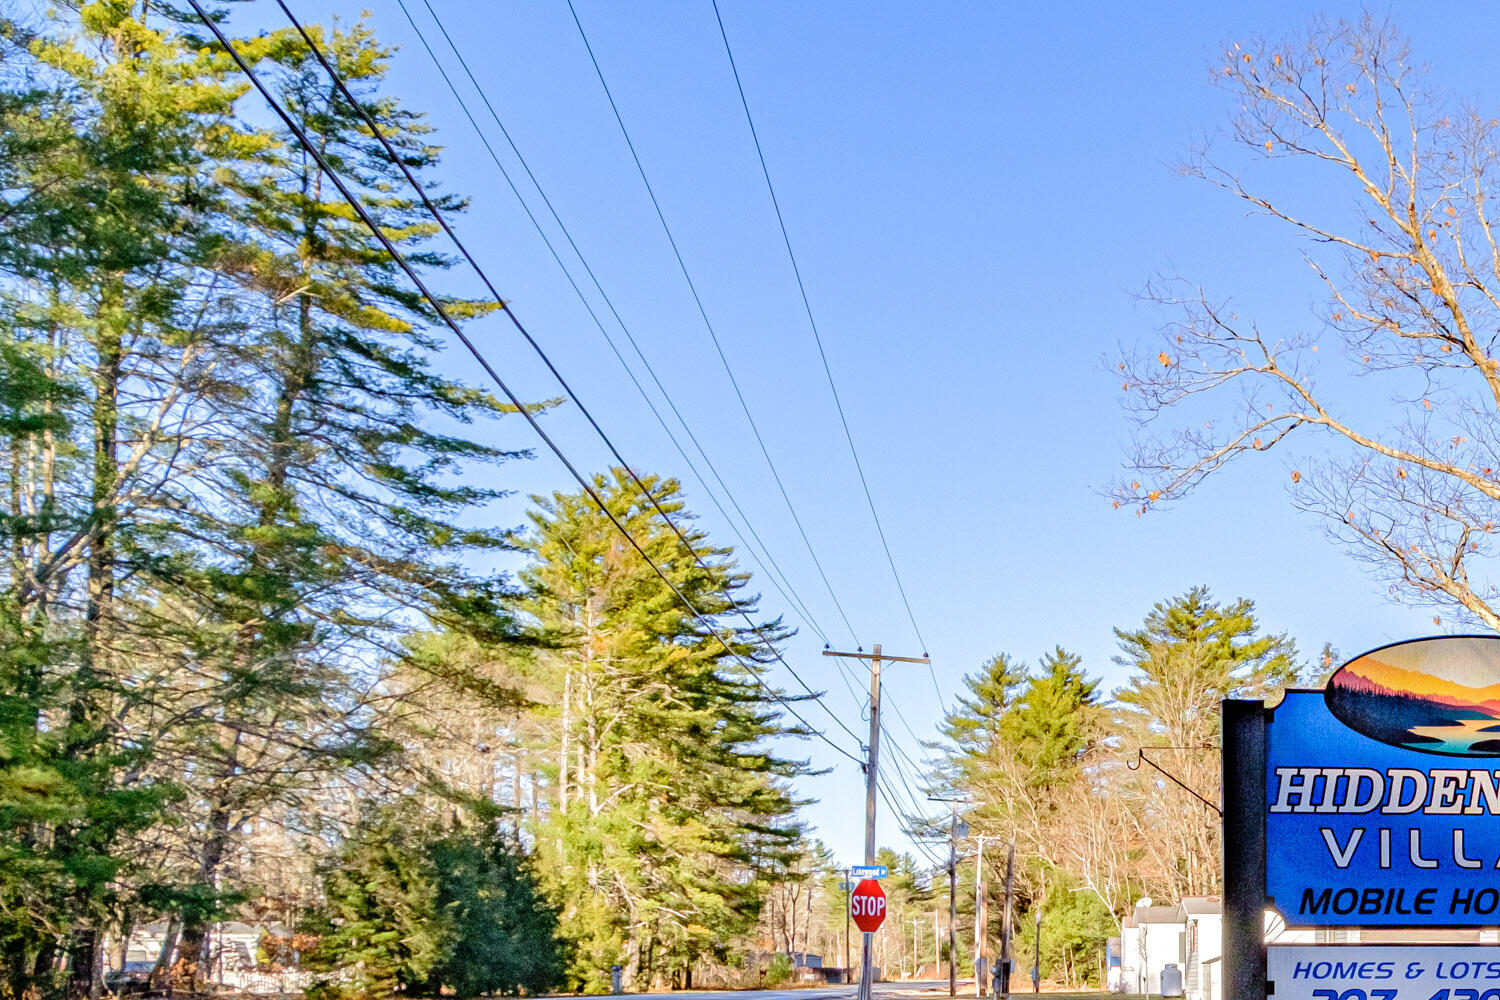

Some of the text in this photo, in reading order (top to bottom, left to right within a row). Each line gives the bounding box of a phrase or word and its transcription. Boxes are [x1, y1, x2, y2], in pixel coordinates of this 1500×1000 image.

[852, 895, 885, 916] STOP
[1299, 888, 1438, 915] MOBILE
[1292, 961, 1395, 980] HOMES
[1404, 961, 1425, 980] &
